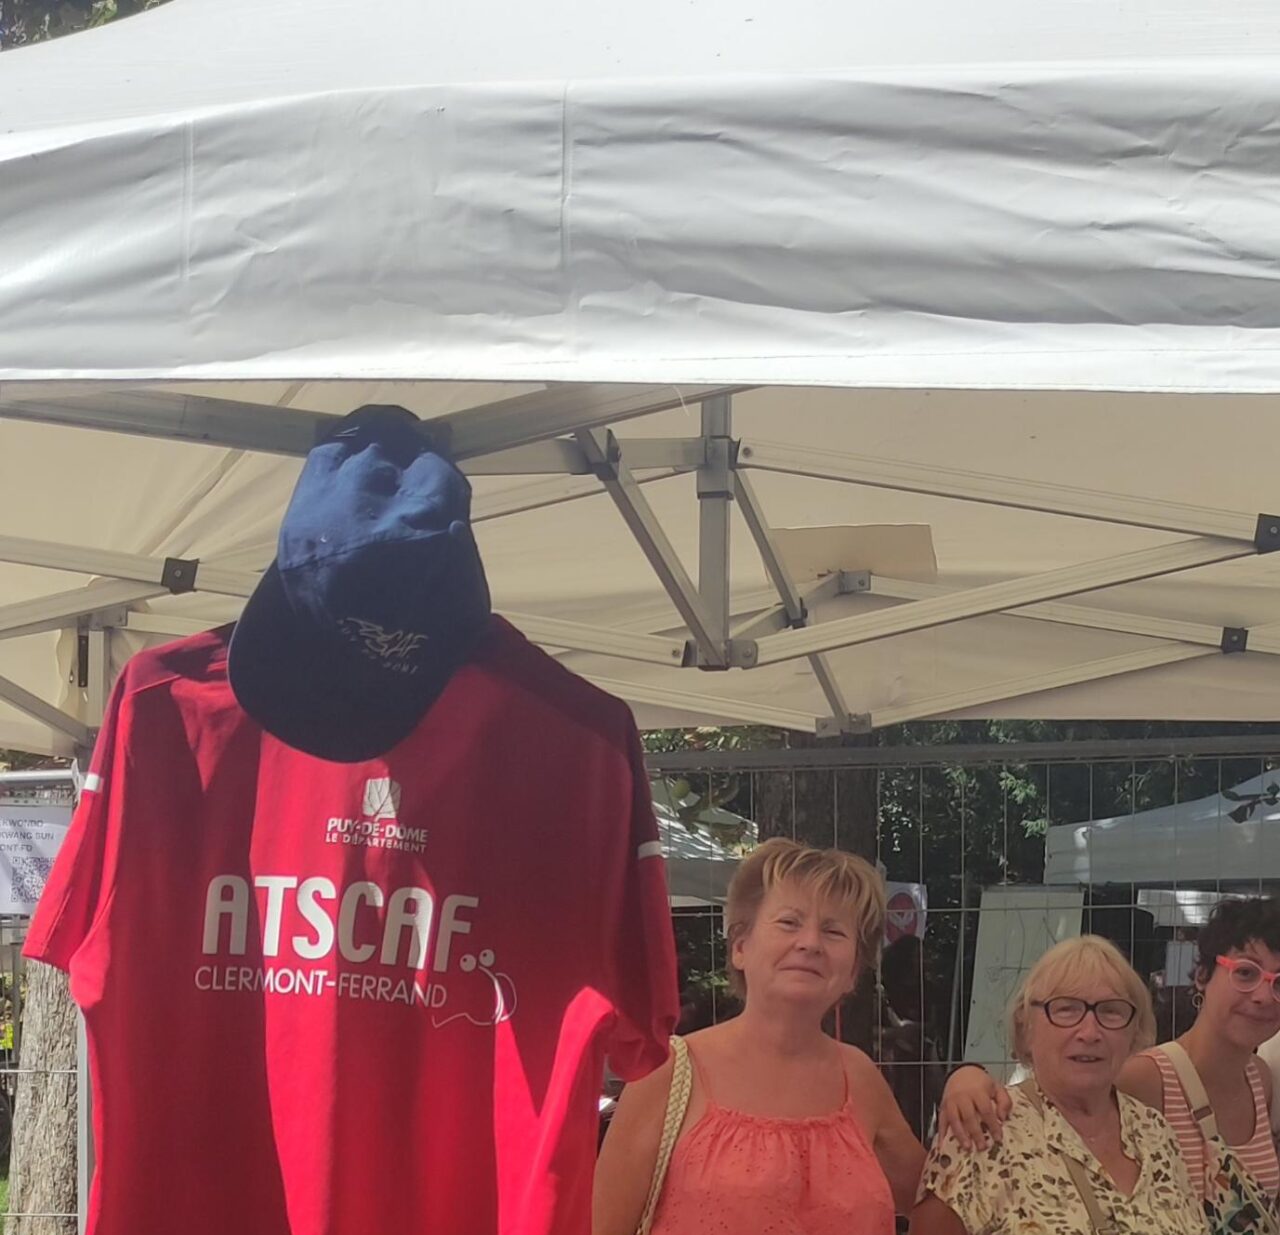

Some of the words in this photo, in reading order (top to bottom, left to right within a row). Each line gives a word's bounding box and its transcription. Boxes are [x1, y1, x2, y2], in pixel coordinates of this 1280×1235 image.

[325, 832, 338, 843] LE
[202, 874, 479, 973] ATSCAF
[194, 965, 448, 1008] CLERMONT-FERRAND
